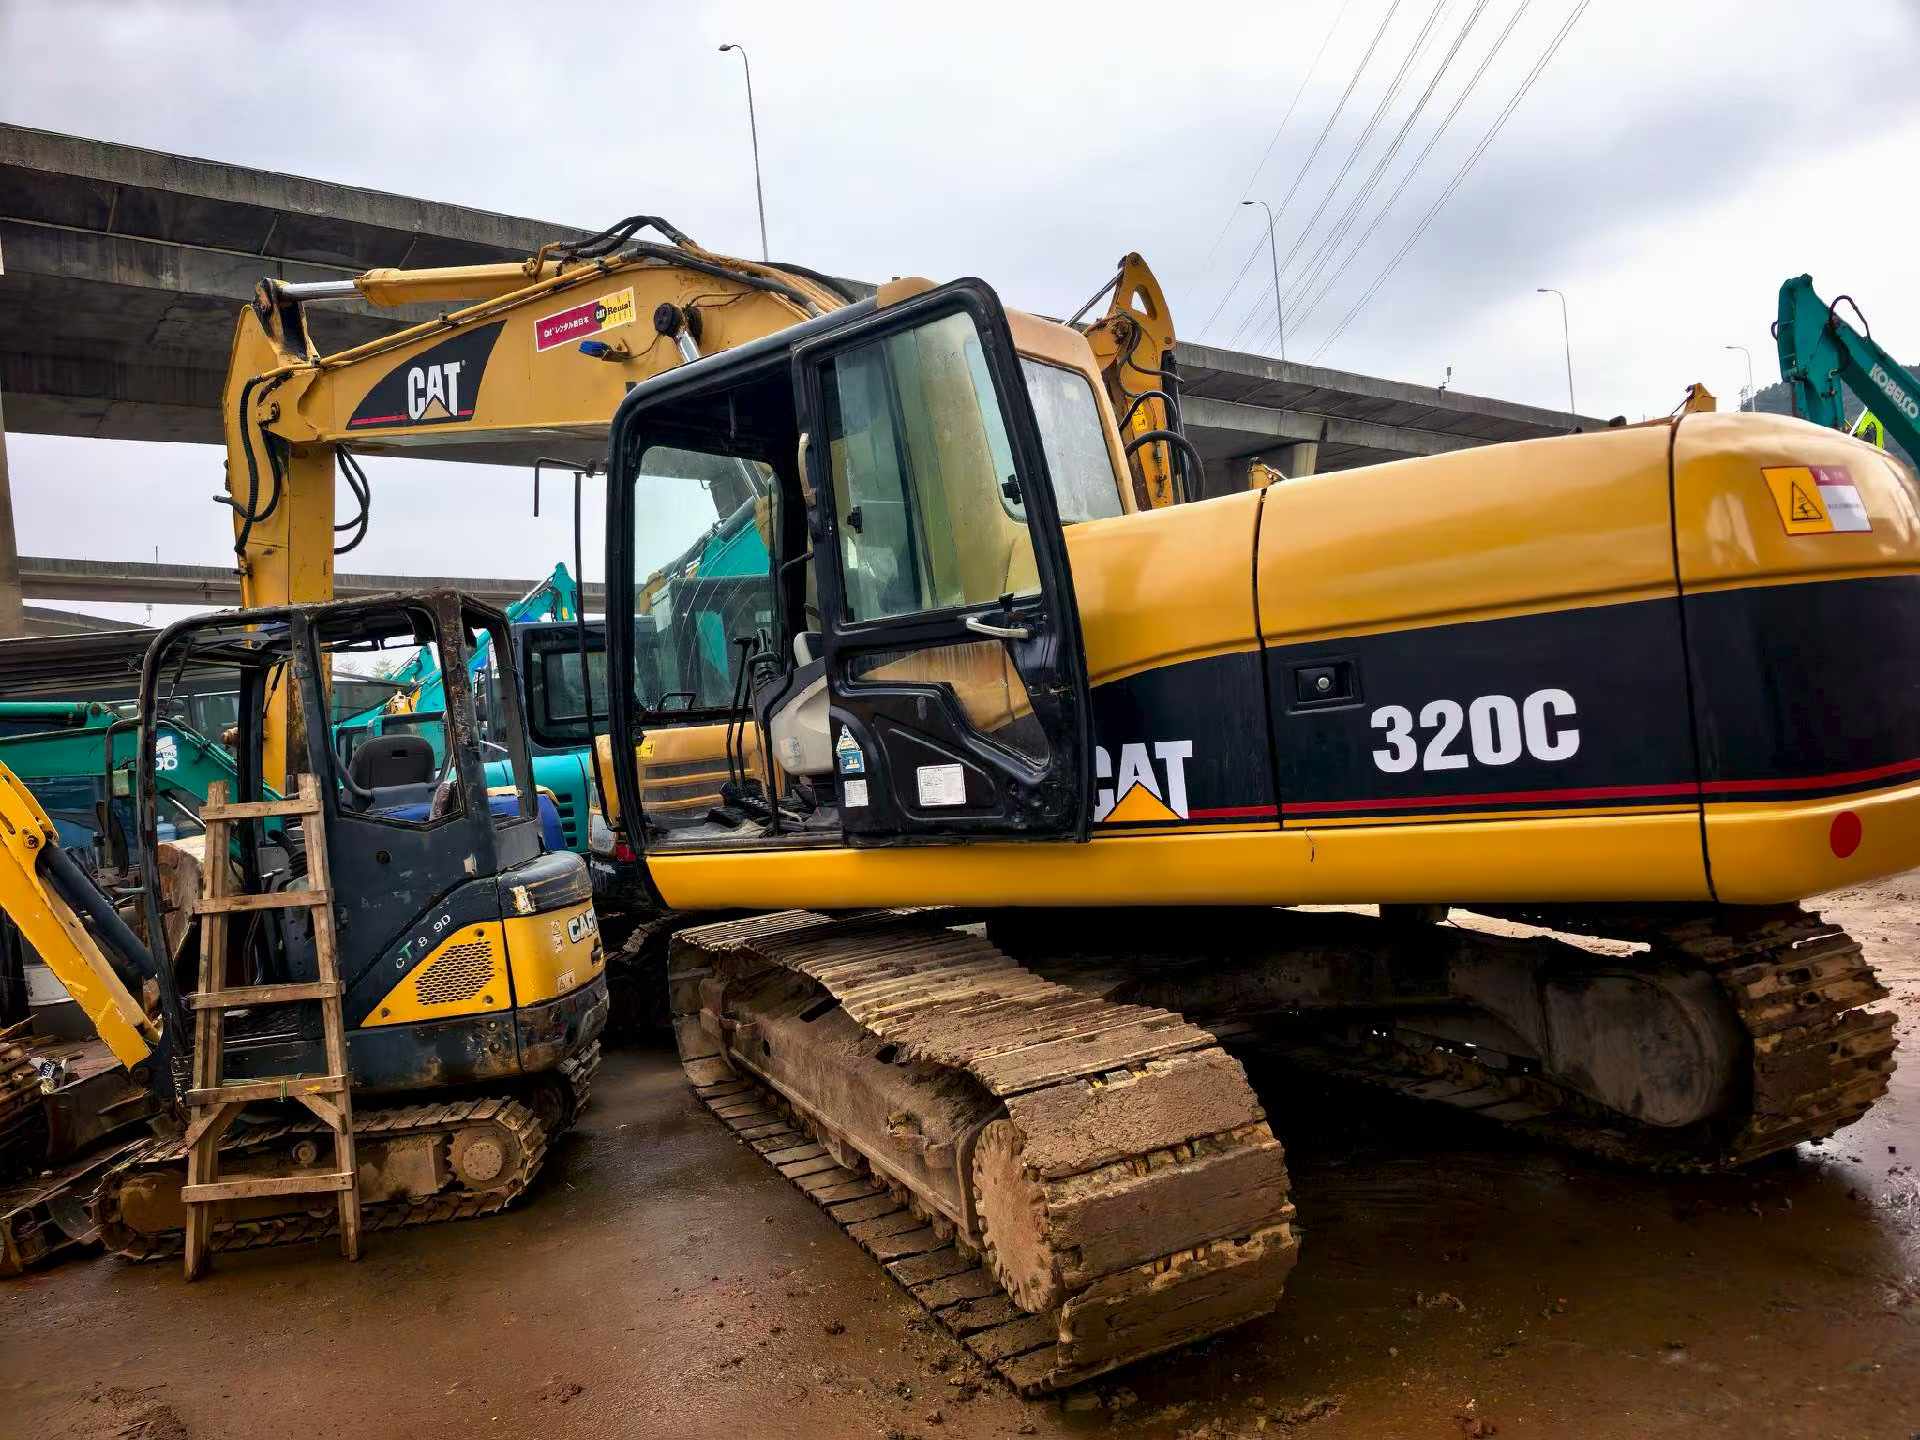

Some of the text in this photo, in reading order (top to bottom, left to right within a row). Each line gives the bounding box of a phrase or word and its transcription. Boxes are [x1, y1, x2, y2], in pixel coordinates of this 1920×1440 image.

[407, 361, 461, 420] CAT
[1868, 362, 1919, 419] KOBELCO
[1370, 688, 1580, 773] 320C
